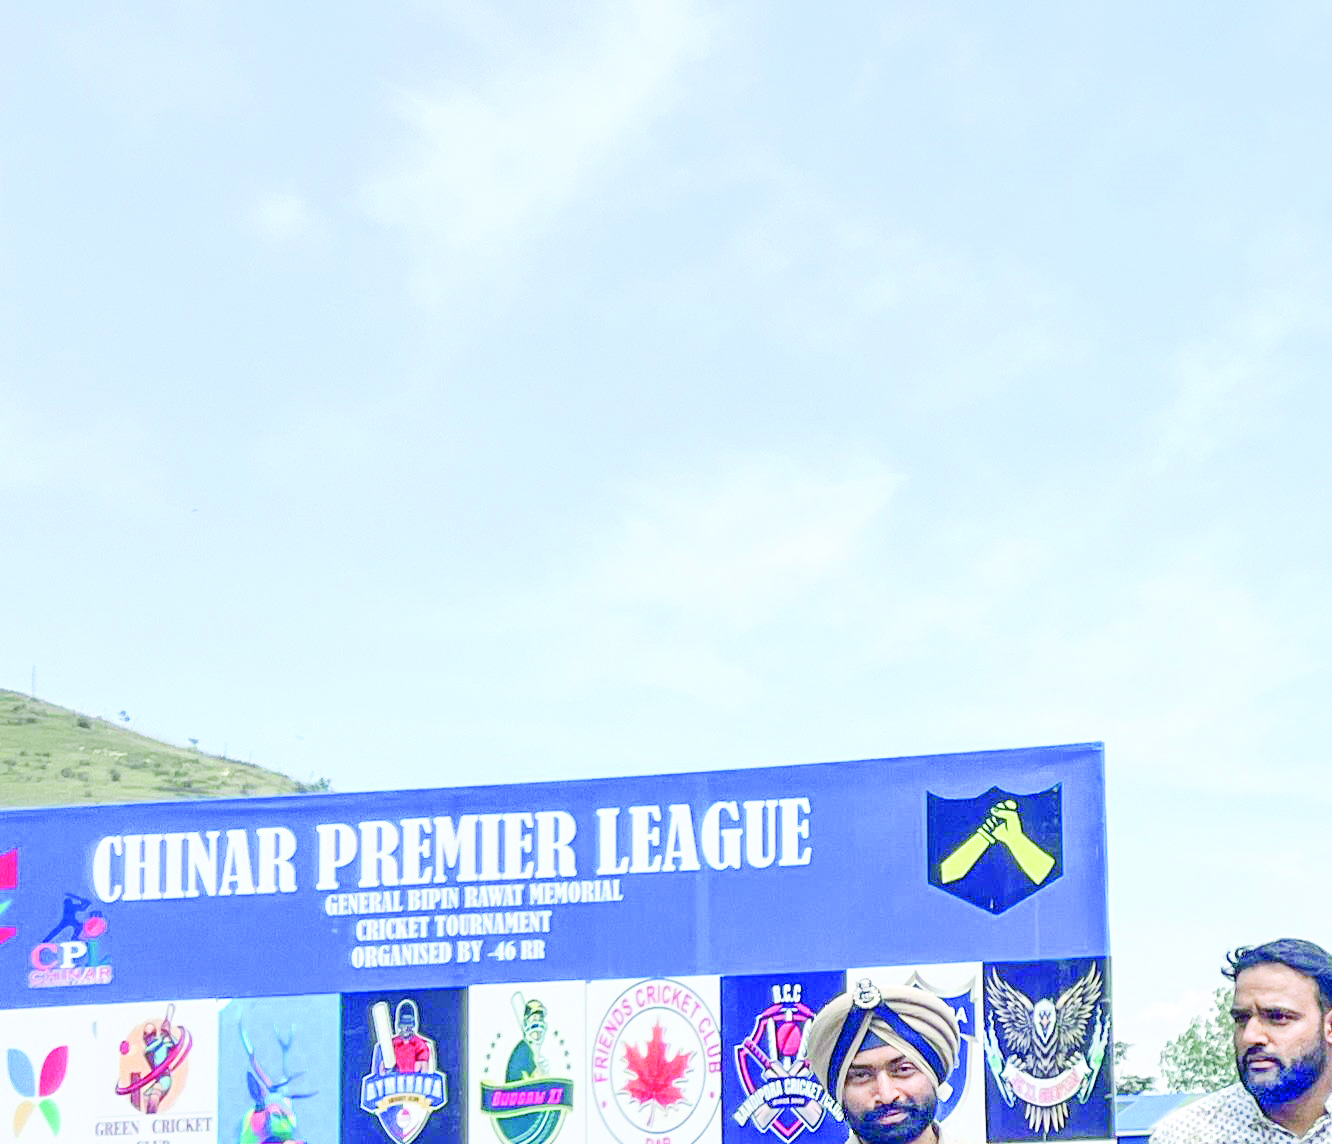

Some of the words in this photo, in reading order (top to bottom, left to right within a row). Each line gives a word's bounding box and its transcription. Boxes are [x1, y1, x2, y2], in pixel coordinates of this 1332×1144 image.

[92, 826, 298, 903] CHINAR
[315, 810, 577, 891] PREMIER
[597, 797, 812, 876] LEAGUE
[325, 891, 403, 916] GENERAL
[407, 888, 460, 912] BIPIN
[464, 884, 525, 909] RAWAT
[529, 879, 624, 905] MEMORIAL
[356, 915, 430, 941] CRICKET
[435, 910, 552, 938] TOURNAMENT
[31, 939, 112, 970] CPL
[351, 942, 452, 968] ORGANISED
[456, 941, 483, 965] BY
[487, 940, 516, 962] -46
[519, 939, 545, 960] RR
[28, 964, 113, 988] CHINAR
[594, 1004, 633, 1083] FRIENDS
[635, 985, 701, 1019] CRICKET
[698, 1018, 721, 1074] CLUB
[491, 1089, 545, 1107] BUDGAM
[547, 1088, 563, 1105] XI
[784, 1077, 823, 1099] CRICKET
[95, 1120, 140, 1137] GREEN
[152, 1116, 212, 1134] CRICKET
